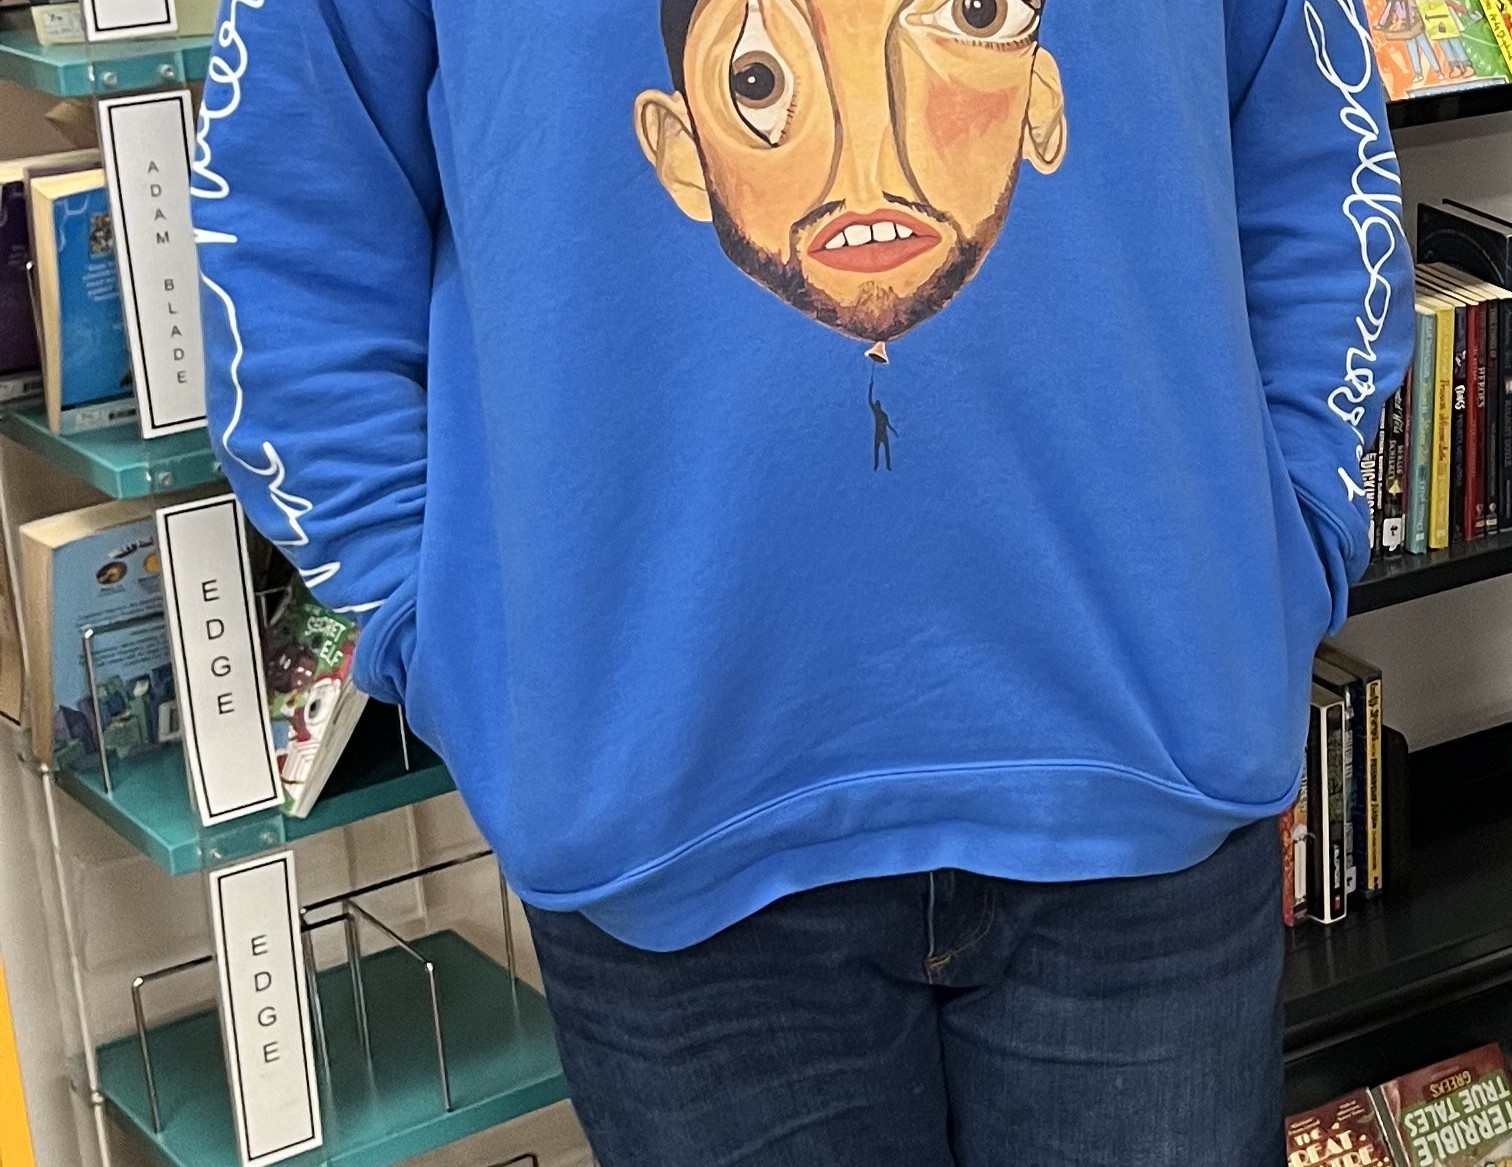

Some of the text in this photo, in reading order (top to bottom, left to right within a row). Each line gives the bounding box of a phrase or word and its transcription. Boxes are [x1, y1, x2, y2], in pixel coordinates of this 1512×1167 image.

[147, 160, 188, 384] ADAM BLADE
[201, 578, 235, 716] EDGE
[251, 933, 280, 1064] EDGE
[1403, 1074, 1512, 1138] TRUE TALES
